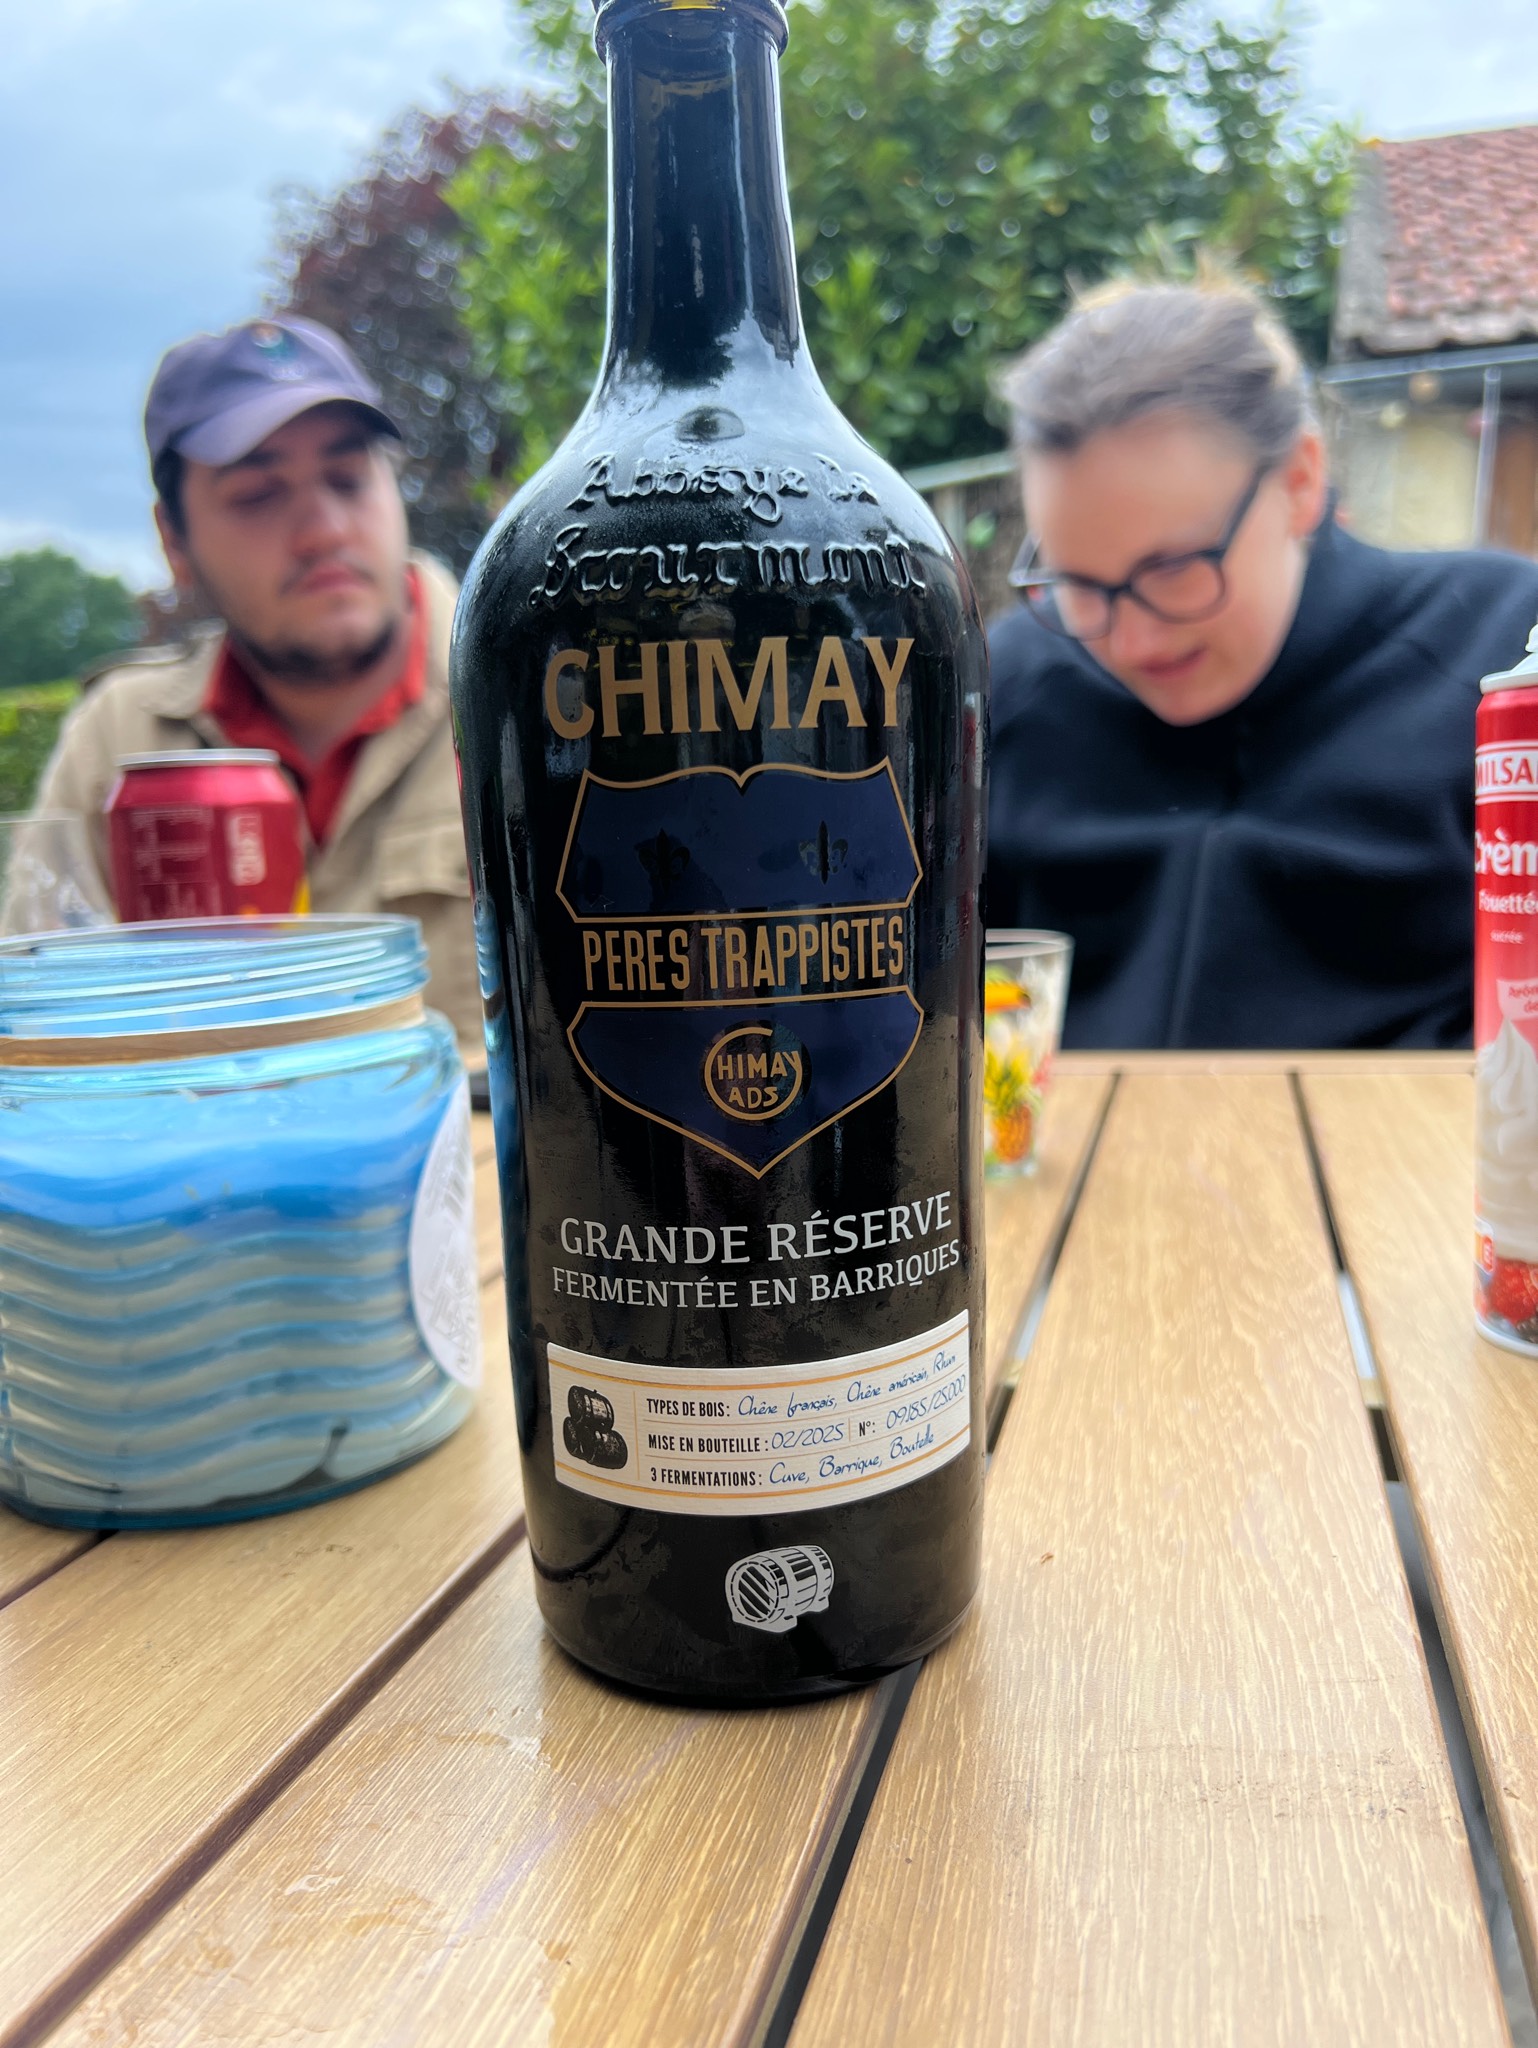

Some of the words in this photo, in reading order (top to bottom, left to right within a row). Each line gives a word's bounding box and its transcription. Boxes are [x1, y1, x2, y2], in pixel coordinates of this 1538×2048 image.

[544, 635, 915, 740] CHIMAY
[1475, 757, 1538, 787] MILSA
[582, 928, 692, 991] PERES
[700, 914, 905, 990] TRAPPISTES
[728, 1087, 779, 1109] ADS
[560, 1217, 751, 1264] GRANDE
[766, 1190, 952, 1262] RÉSERVE
[552, 1266, 740, 1309] FERMENTÉE
[749, 1277, 798, 1308] EN
[809, 1238, 961, 1302] BARRIQUES
[646, 1398, 679, 1417] TYPES
[682, 1402, 696, 1417] DE
[699, 1402, 730, 1418] BOIS:
[737, 1395, 778, 1416] Chêne
[786, 1392, 838, 1418] français,
[846, 1381, 881, 1403] Chêne
[648, 1434, 676, 1451] MISE
[679, 1437, 694, 1452] EN
[698, 1437, 760, 1453] BOUTEILLE
[771, 1422, 845, 1450] 02/2025
[650, 1467, 658, 1482] 3
[661, 1468, 763, 1487] FERMENTATIONS:
[769, 1461, 810, 1484] Cuve,
[819, 1454, 883, 1478] Barrique,
